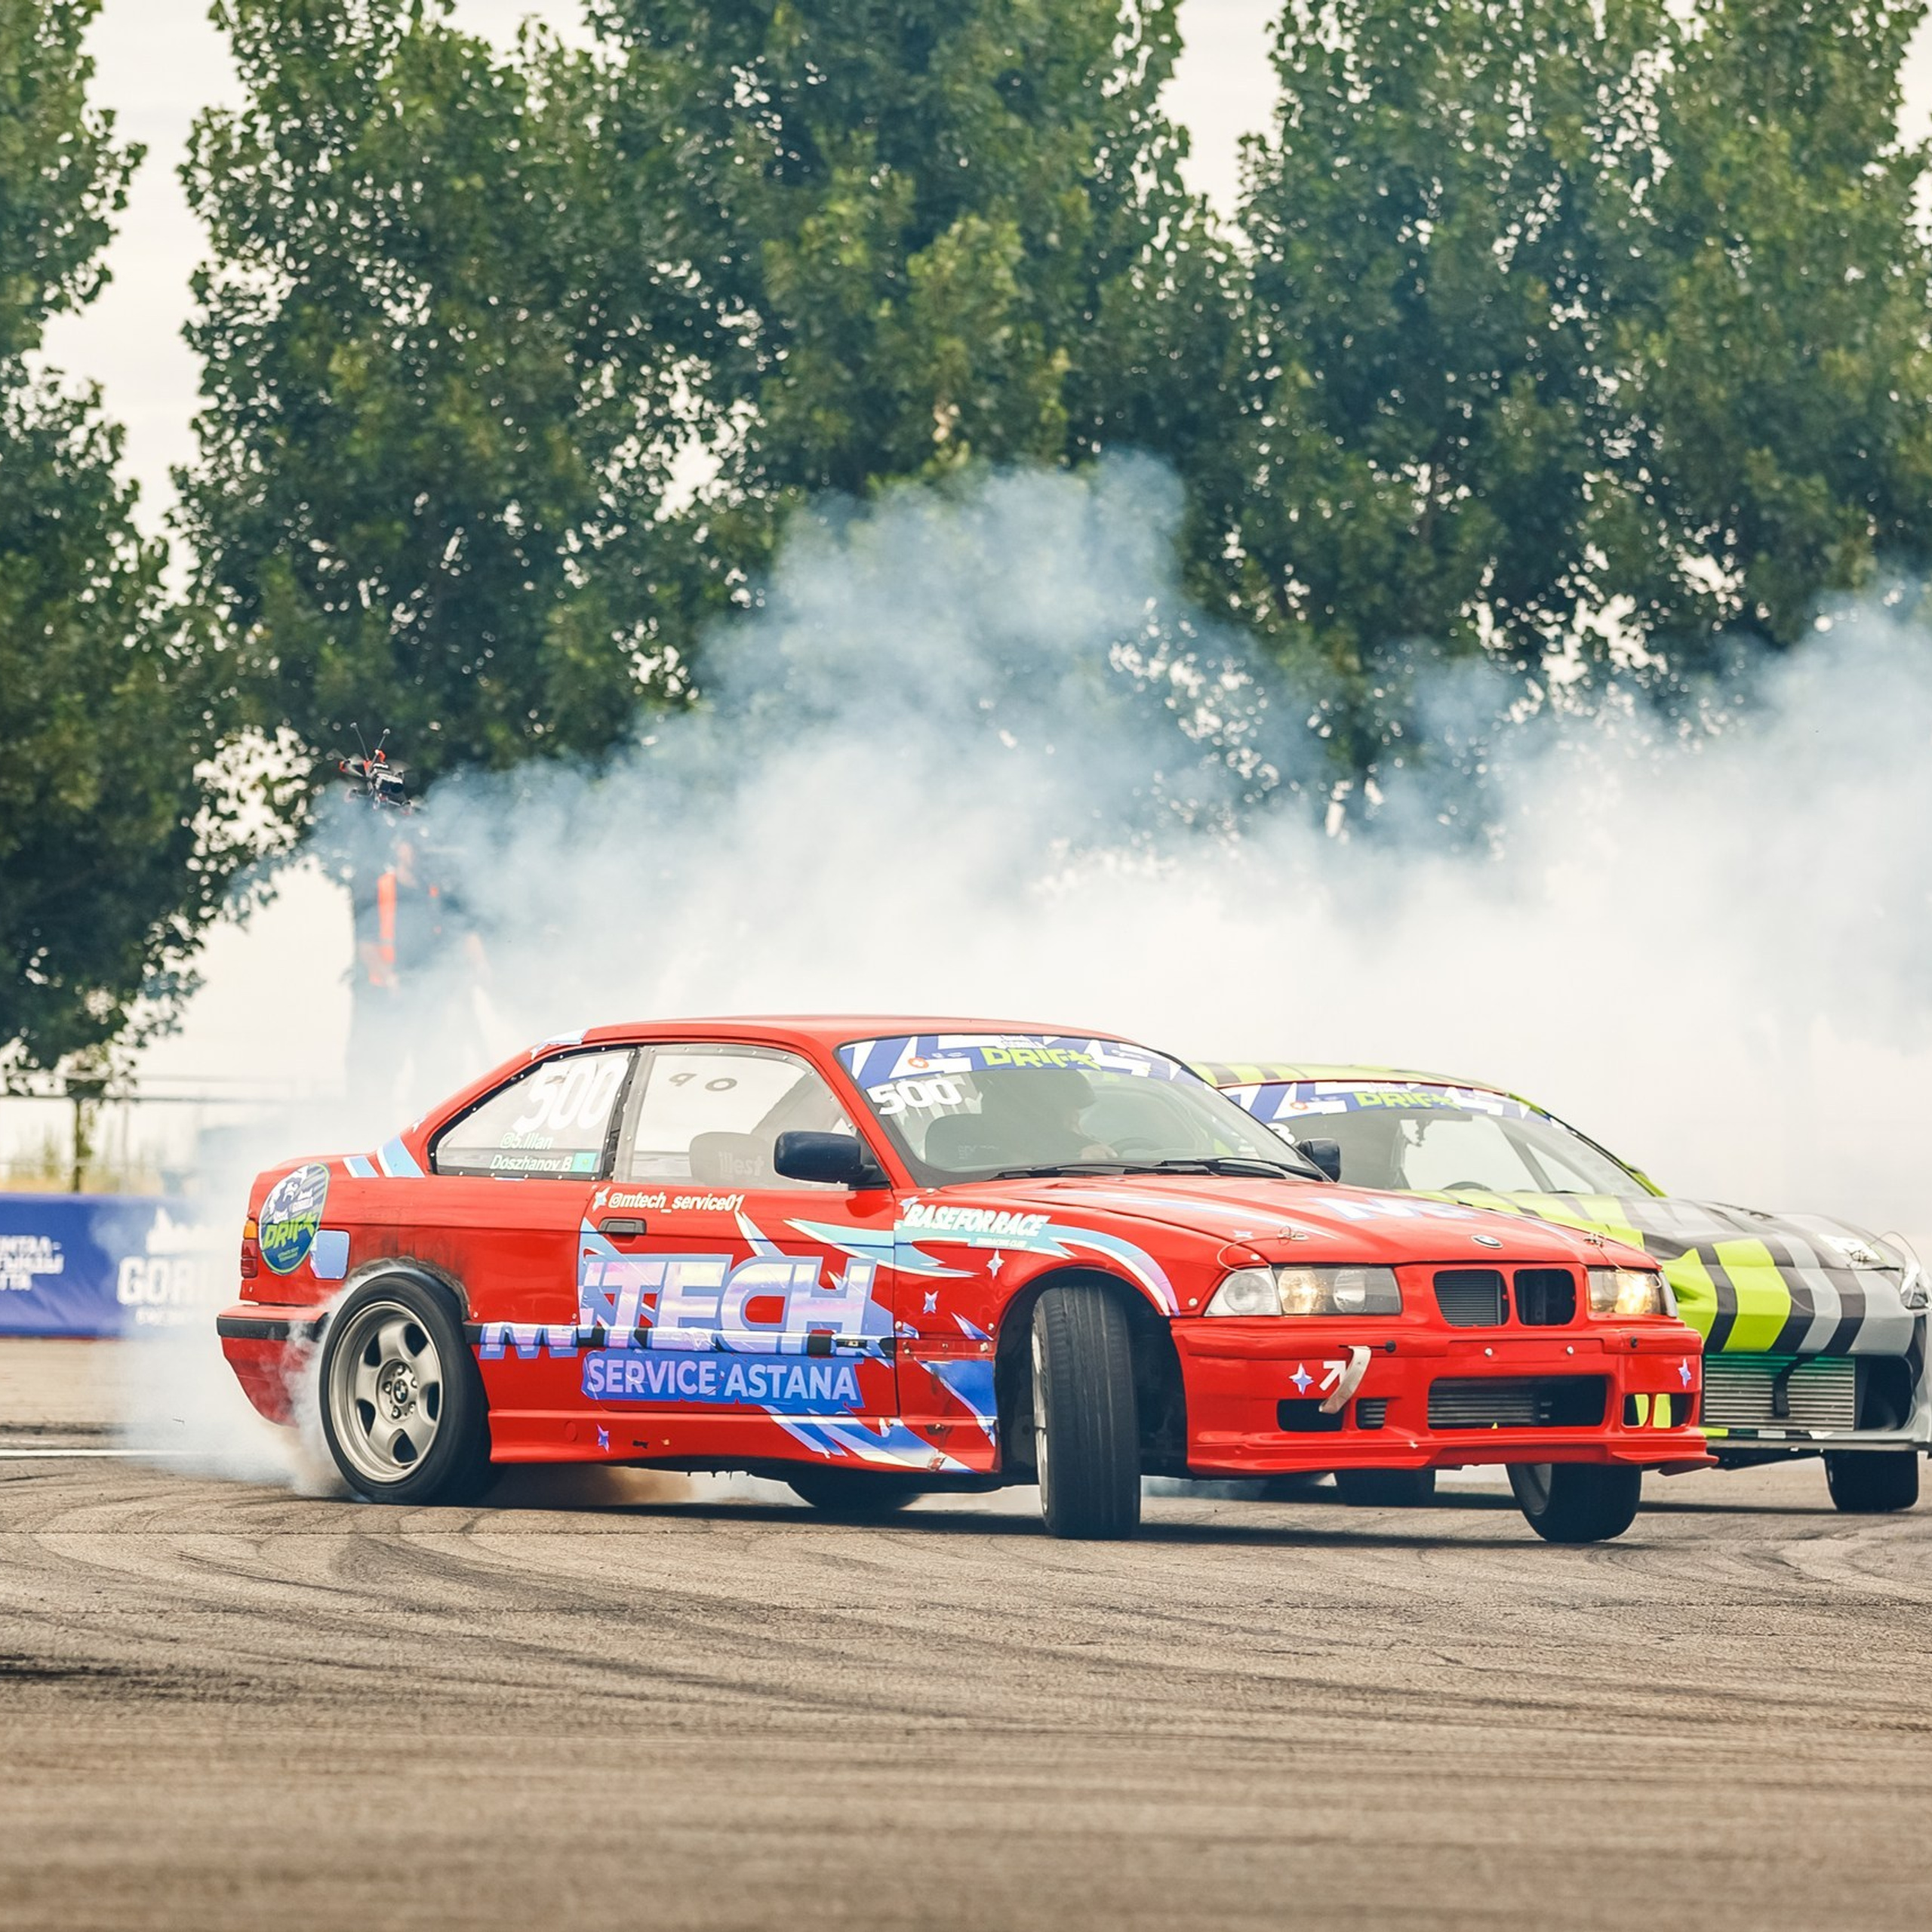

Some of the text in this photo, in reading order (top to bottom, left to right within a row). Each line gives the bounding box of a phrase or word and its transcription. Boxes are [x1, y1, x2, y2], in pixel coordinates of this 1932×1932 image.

[512, 1057, 629, 1132] 500
[866, 1079, 963, 1115] 500
[490, 1154, 561, 1171] Doszhanov
[608, 1192, 745, 1213] @mtech_service01
[904, 1204, 1051, 1237] BASEFORRACE
[587, 1358, 857, 1400] SERVICE ASTANA
